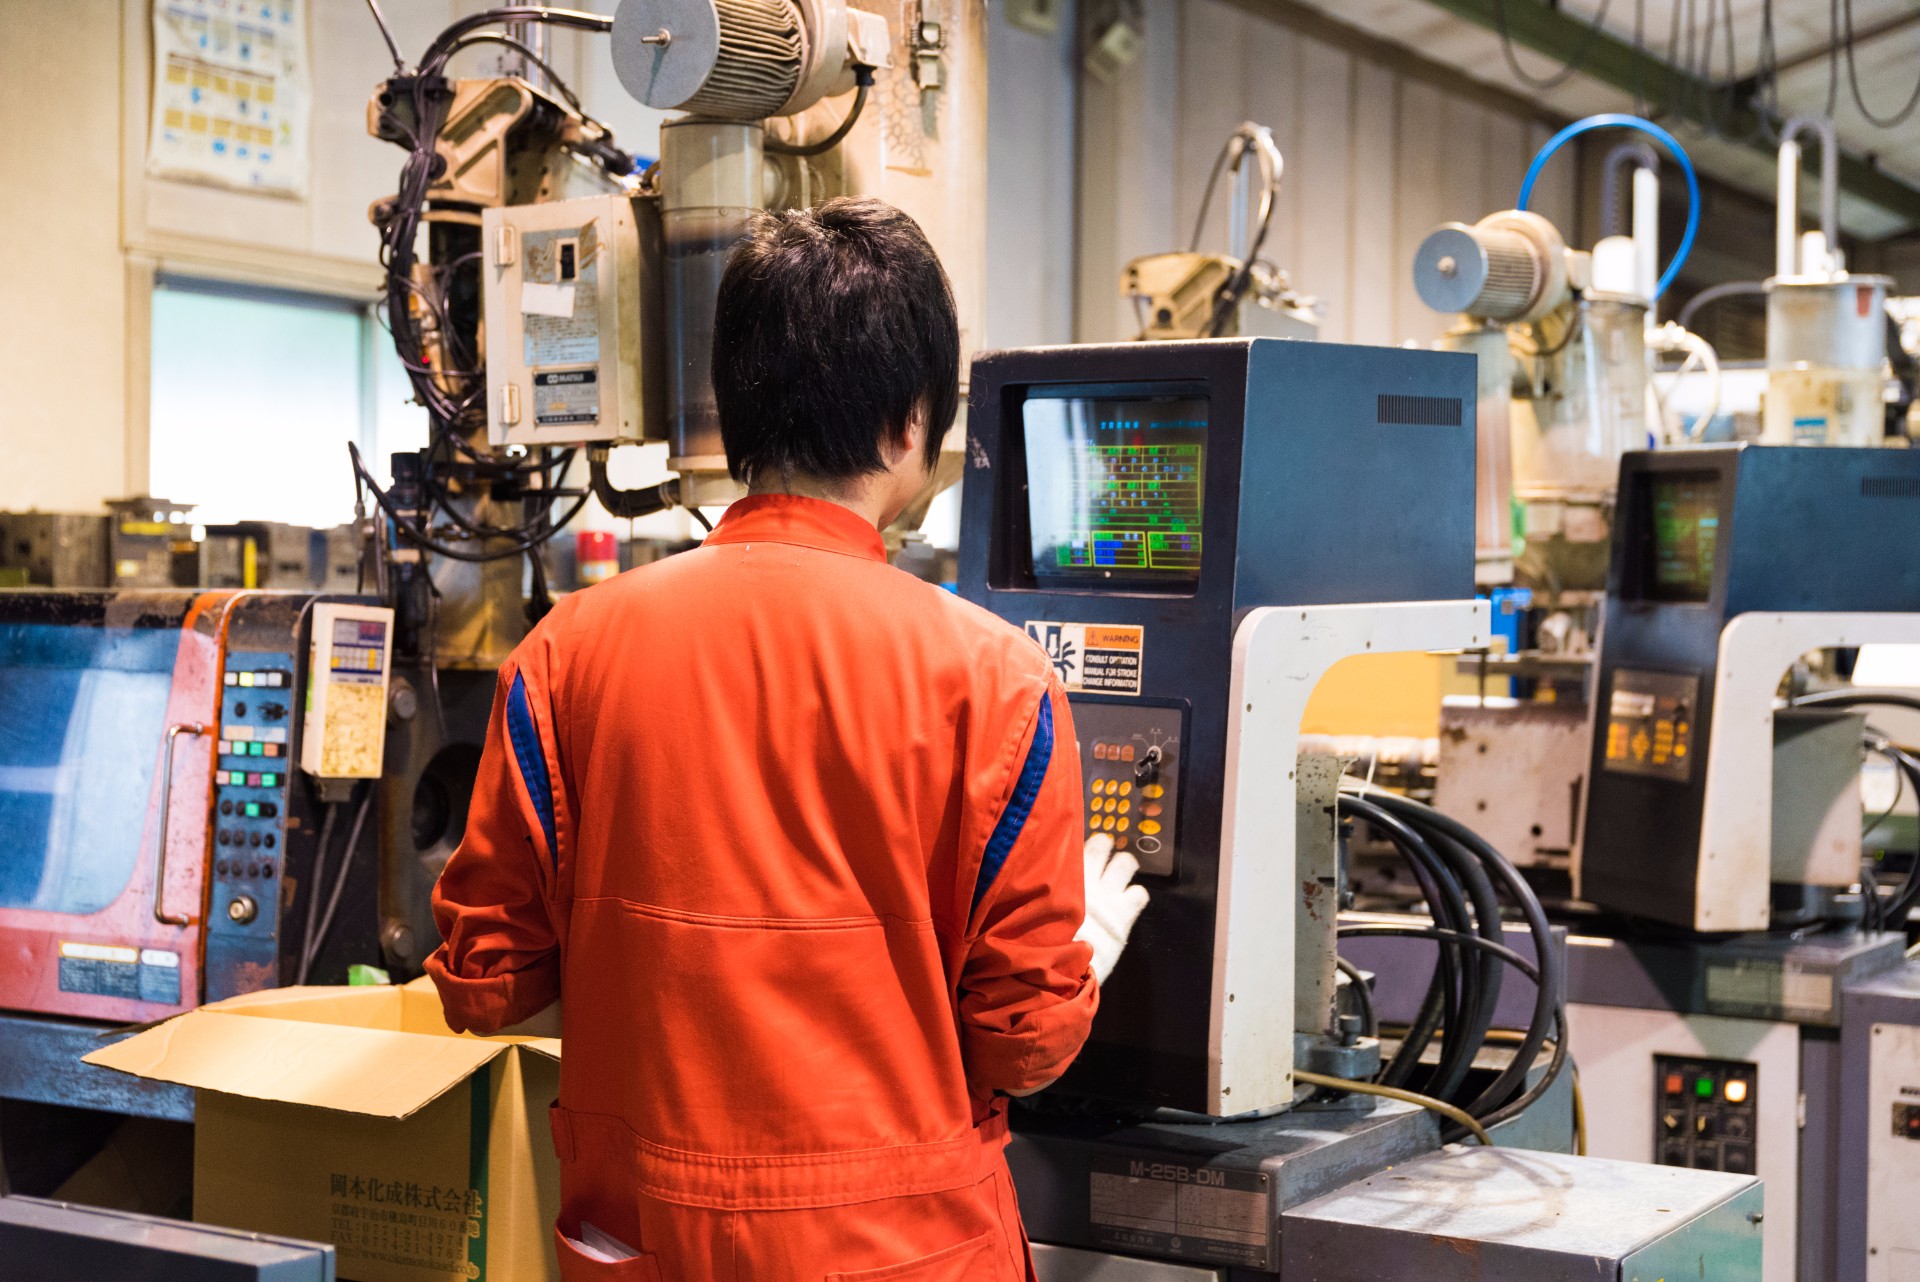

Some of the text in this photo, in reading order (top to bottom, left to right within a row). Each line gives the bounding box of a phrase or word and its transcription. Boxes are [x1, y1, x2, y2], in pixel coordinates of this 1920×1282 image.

[1103, 635, 1139, 643] WARNING
[1085, 654, 1109, 664] CONSULT
[1084, 667, 1138, 678] MANUAL FOR STROKE
[1083, 677, 1137, 688] CHANGE INFORMATION
[1130, 1161, 1225, 1186] M-25B-DM
[331, 1173, 478, 1216] 岡本化成株式会社
